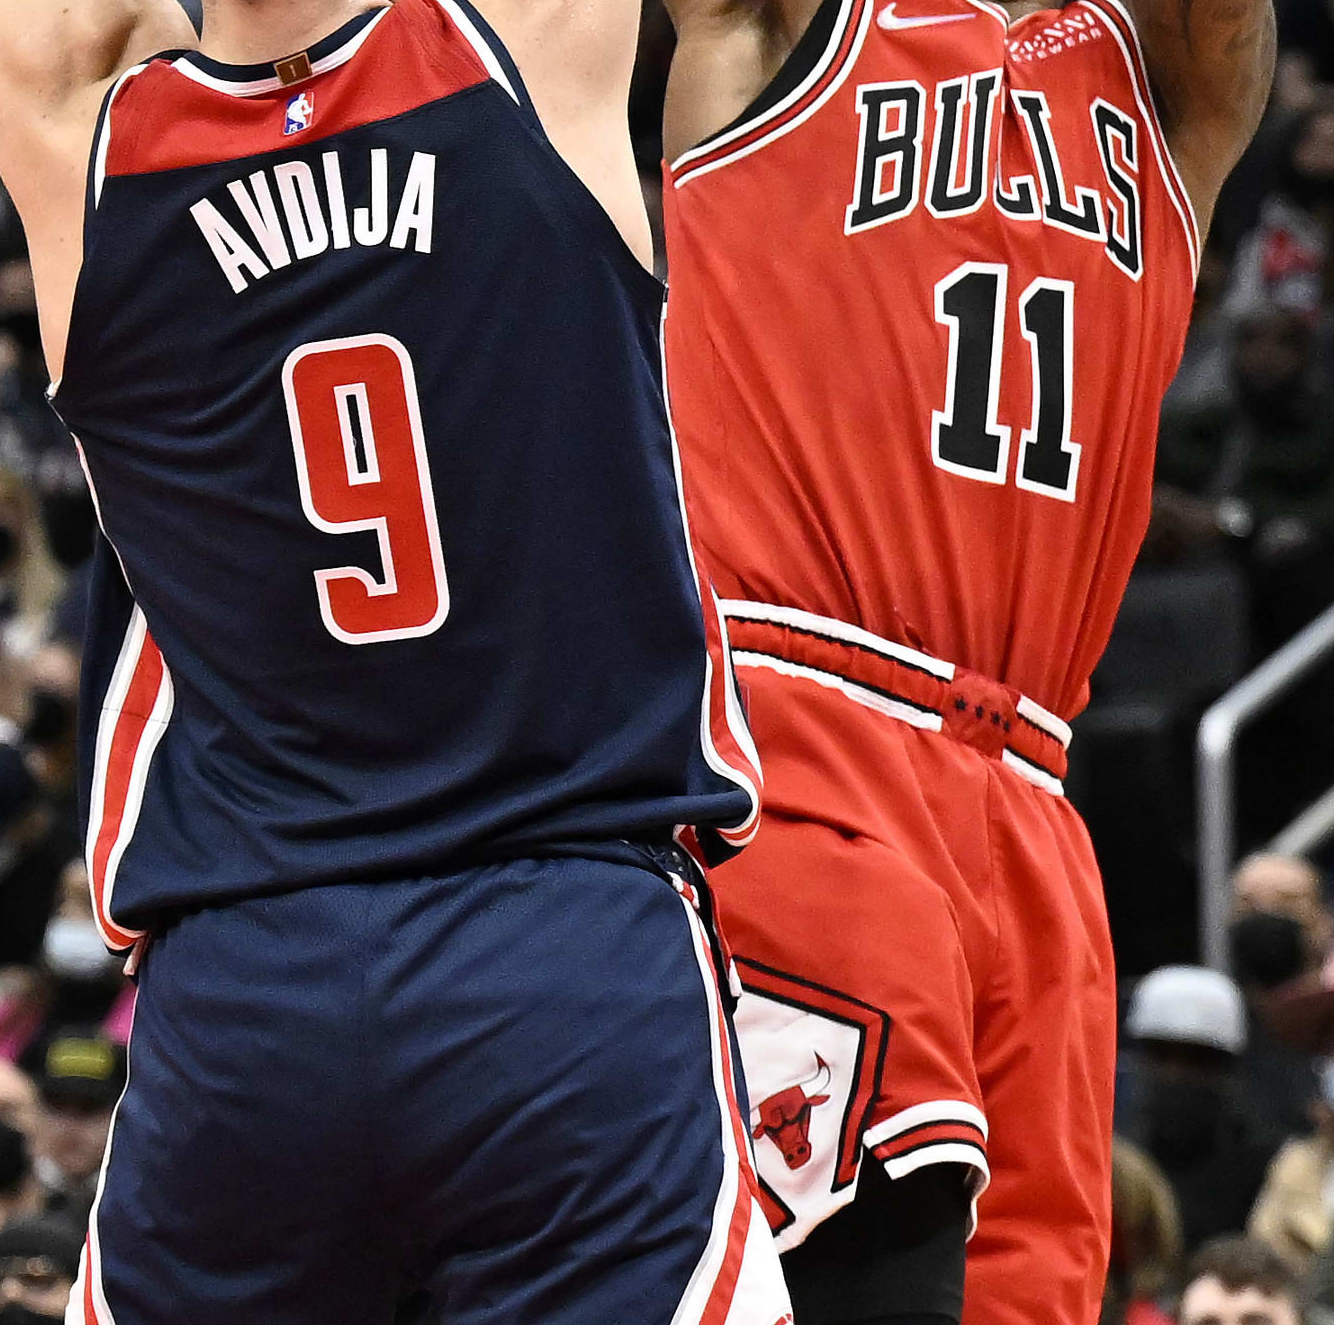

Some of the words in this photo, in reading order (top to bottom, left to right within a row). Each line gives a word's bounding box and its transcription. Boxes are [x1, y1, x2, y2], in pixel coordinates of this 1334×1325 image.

[189, 148, 436, 294] AVDIJA
[281, 332, 450, 646] 9
[932, 261, 1081, 503] 11
